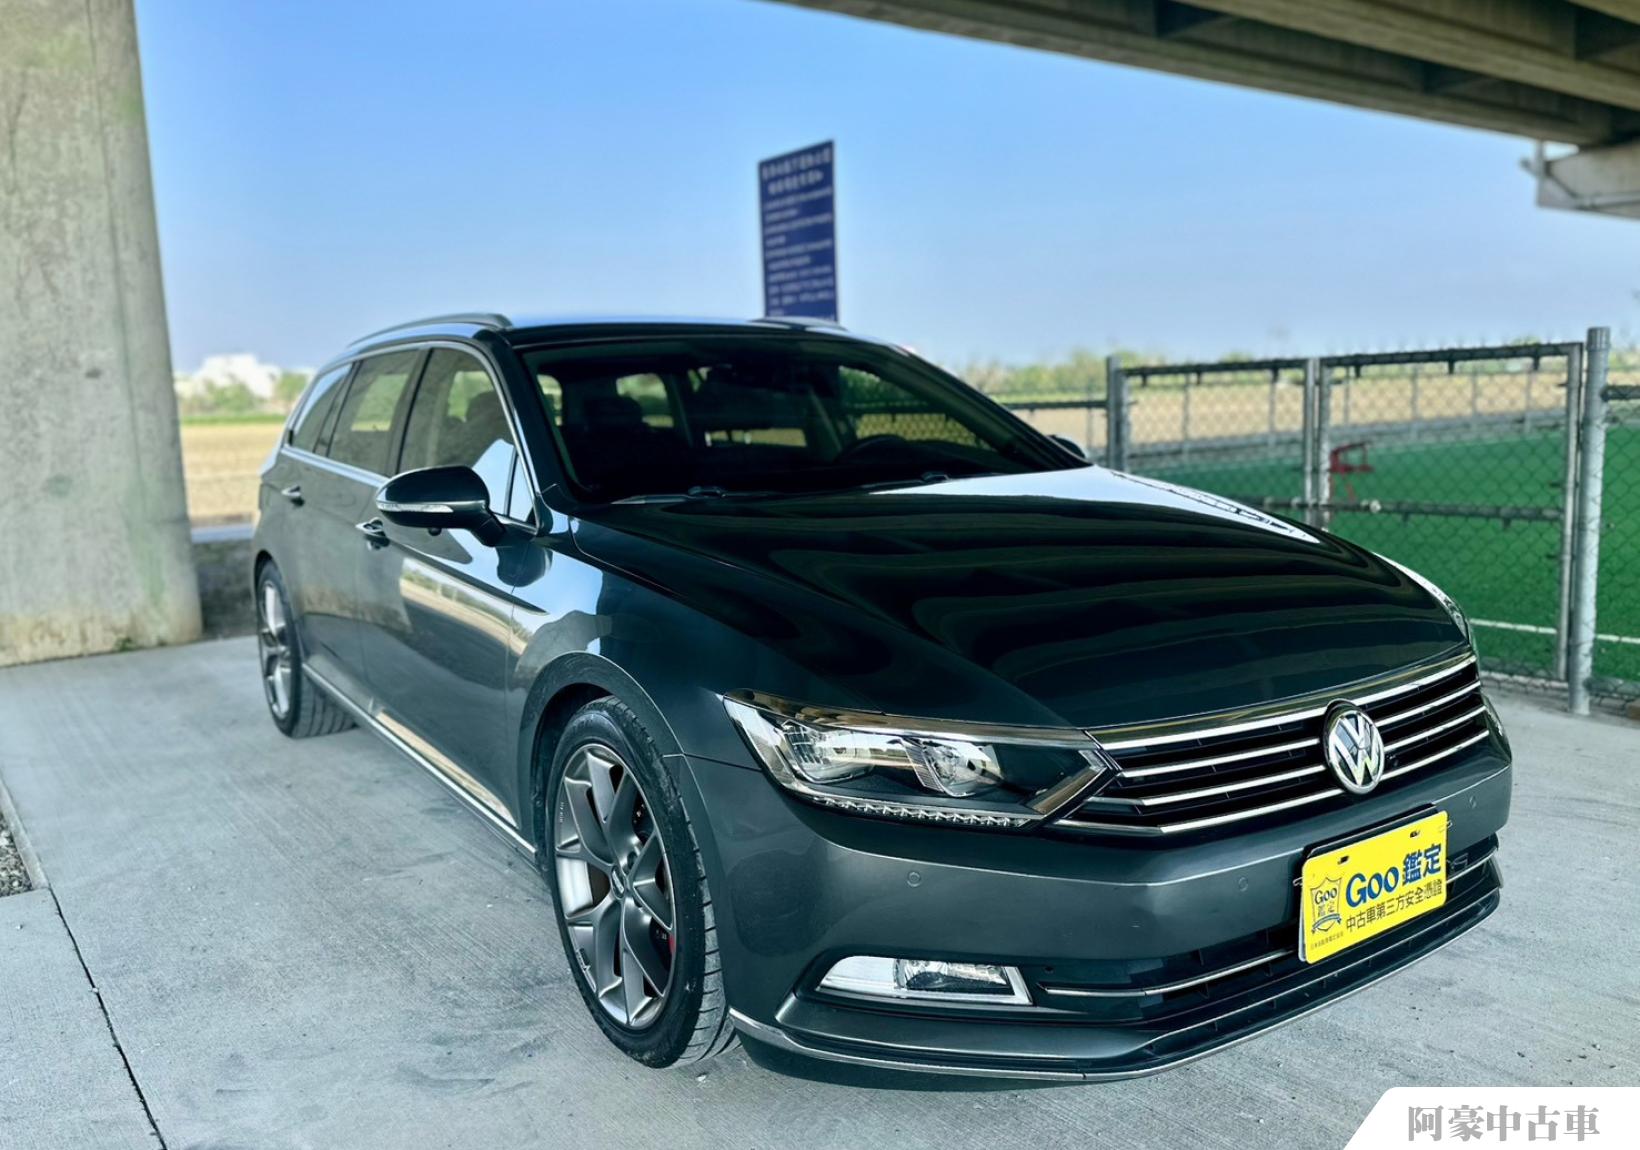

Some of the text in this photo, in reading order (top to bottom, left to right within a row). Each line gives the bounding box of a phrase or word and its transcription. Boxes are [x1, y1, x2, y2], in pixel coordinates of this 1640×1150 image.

[1314, 887, 1337, 904] Goo
[1346, 844, 1441, 907] Goo 鑑定
